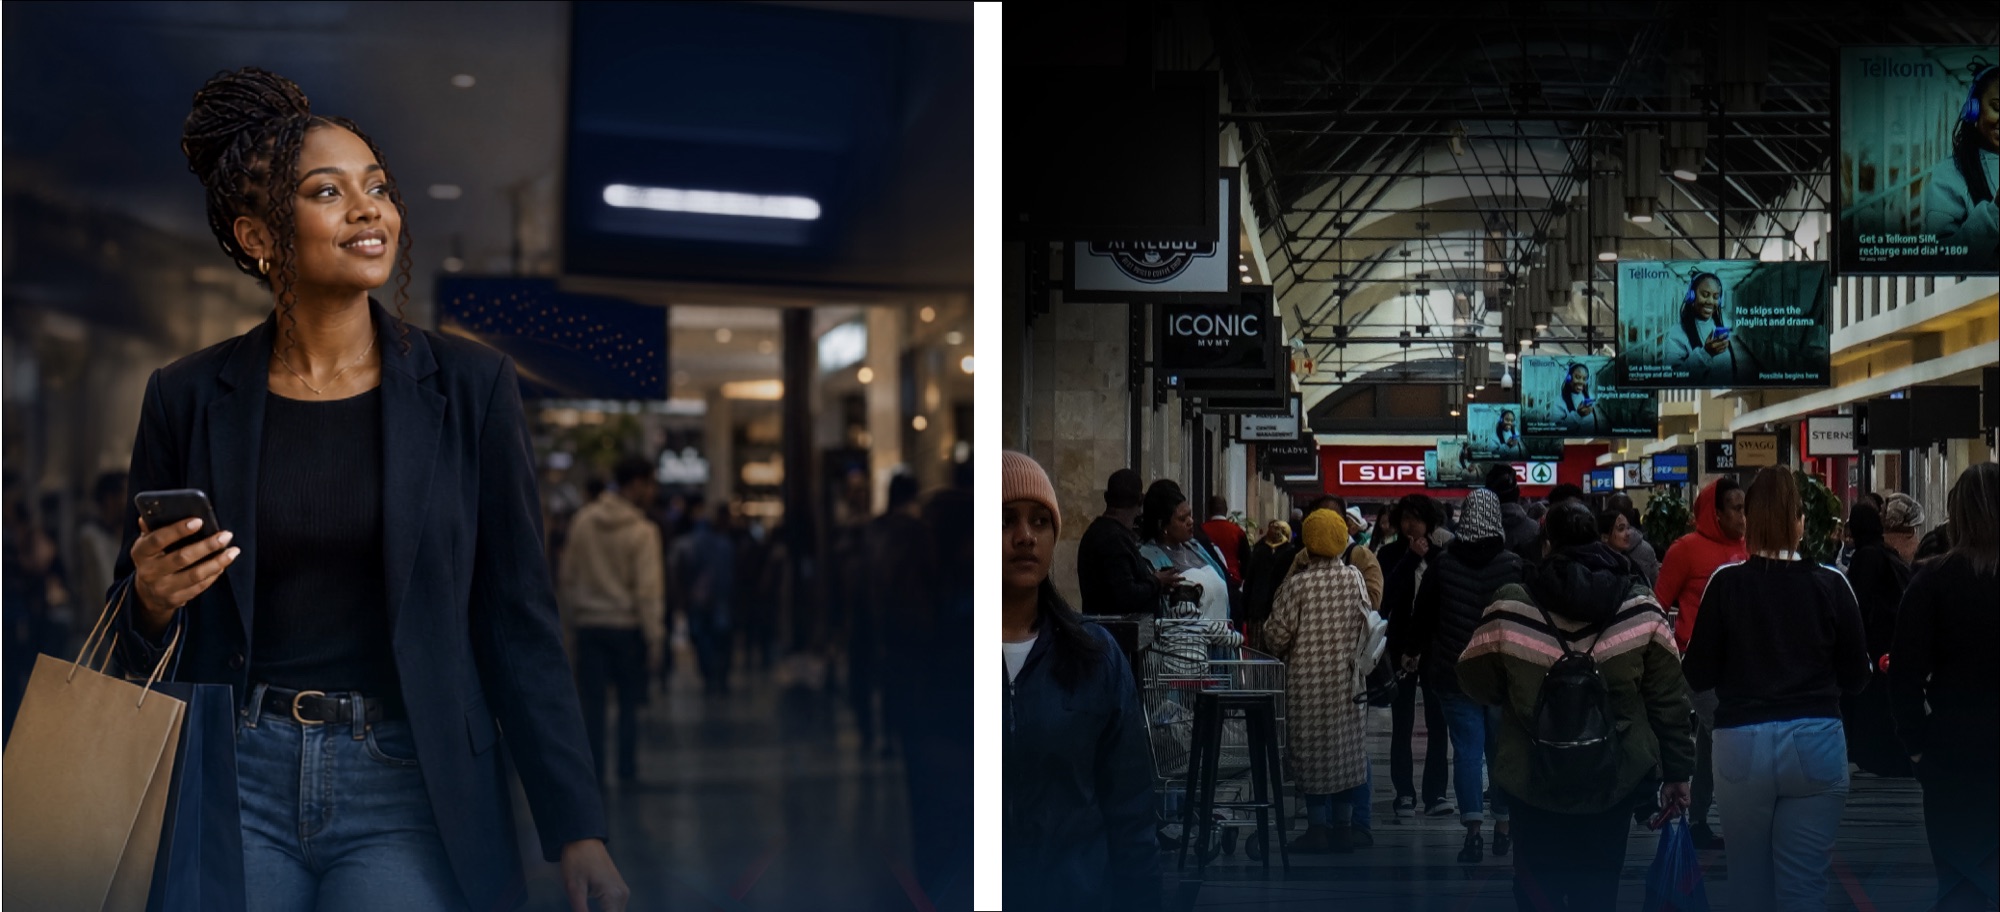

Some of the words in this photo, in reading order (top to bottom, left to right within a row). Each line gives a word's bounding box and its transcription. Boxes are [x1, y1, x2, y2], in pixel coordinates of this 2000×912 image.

[1859, 57, 1933, 78] Telkom
[1859, 234, 1876, 244] Get
[1877, 235, 1884, 244] a
[1885, 233, 1917, 244] Telkom
[1918, 233, 1939, 245] SIM,
[1859, 246, 1900, 258] recharge
[1901, 246, 1919, 256] and
[1920, 246, 1938, 256] dial
[1628, 268, 1669, 279] Telkom
[1735, 306, 1748, 315] No
[1749, 305, 1773, 317] skips
[1773, 308, 1785, 316] on
[1786, 305, 1801, 315] the
[1168, 314, 1258, 336] ICONIC
[1735, 316, 1768, 328] playlist
[1768, 316, 1785, 327] and
[1786, 316, 1815, 327] drama
[1197, 338, 1230, 347] MVMT
[1812, 431, 1853, 440] STERNS
[1738, 440, 1774, 450] SWAGG
[1657, 466, 1672, 474] PEP
